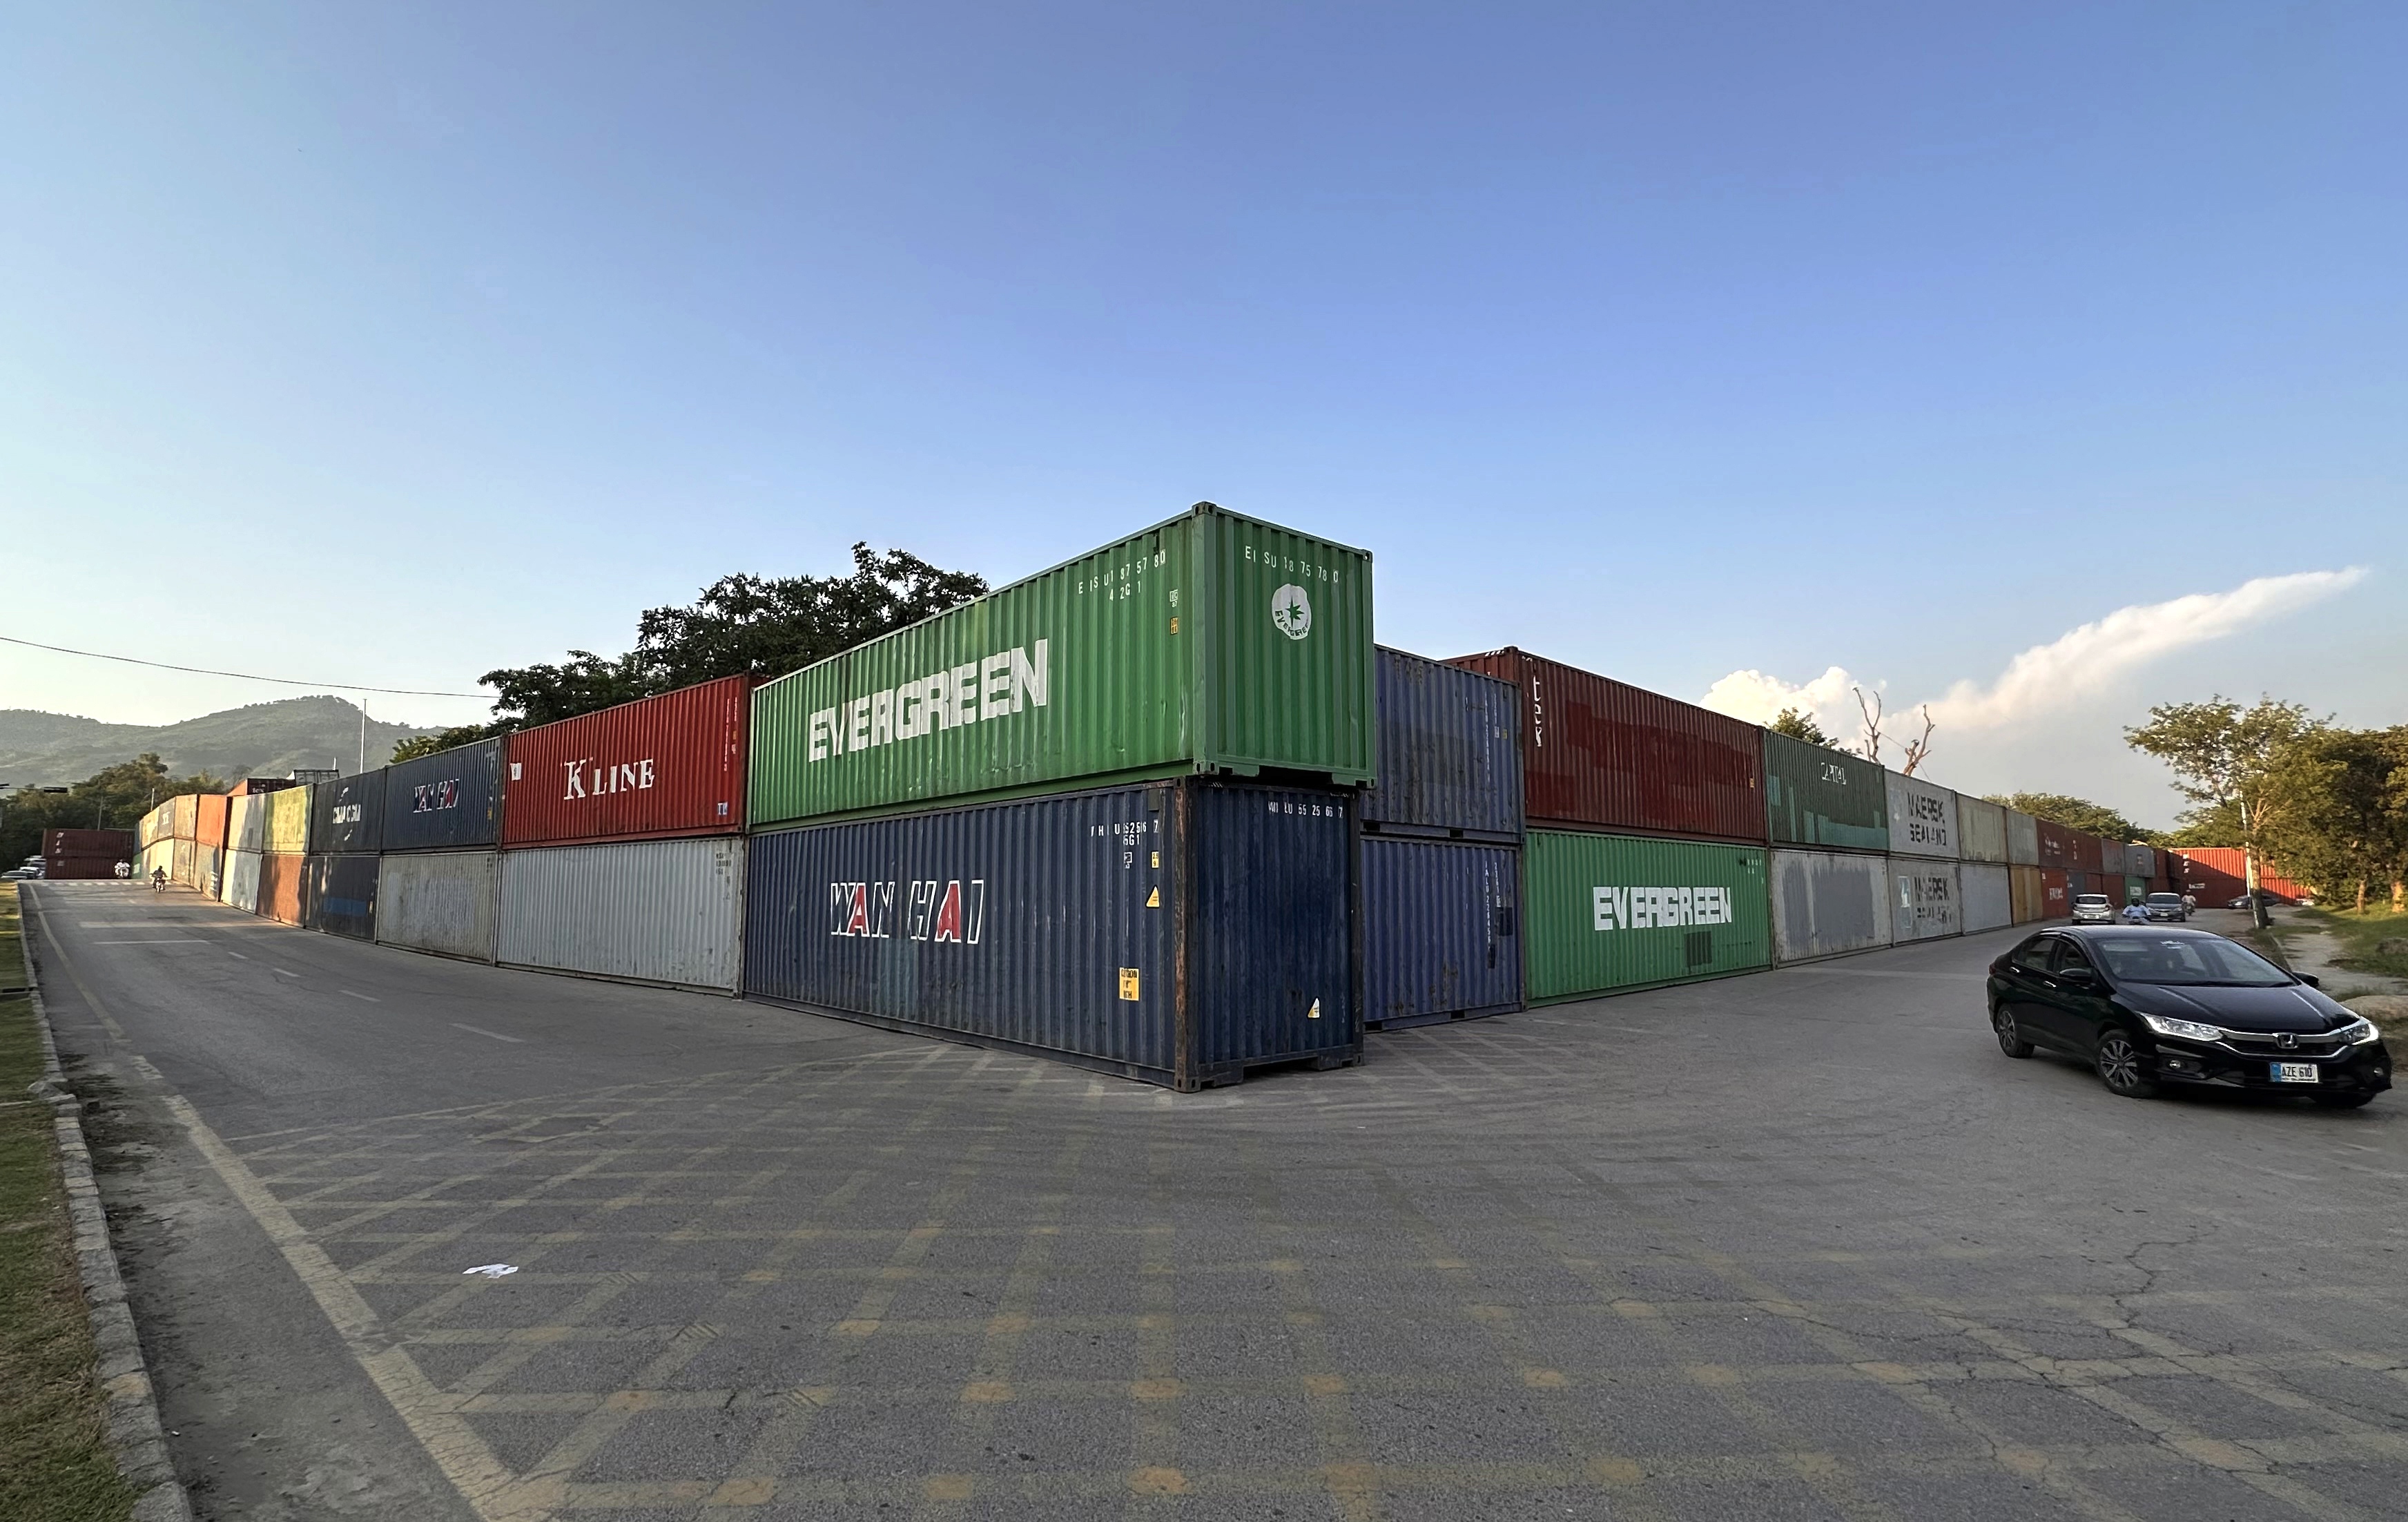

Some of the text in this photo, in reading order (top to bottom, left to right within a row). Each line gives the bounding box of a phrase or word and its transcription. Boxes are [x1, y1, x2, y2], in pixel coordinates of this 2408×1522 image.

[808, 638, 1048, 762] EVERGREEN
[592, 758, 655, 796] LINE
[831, 879, 984, 944] WAN HAI
[1593, 887, 1732, 931] EVERGREEN
[2282, 1066, 2298, 1078] AZE
